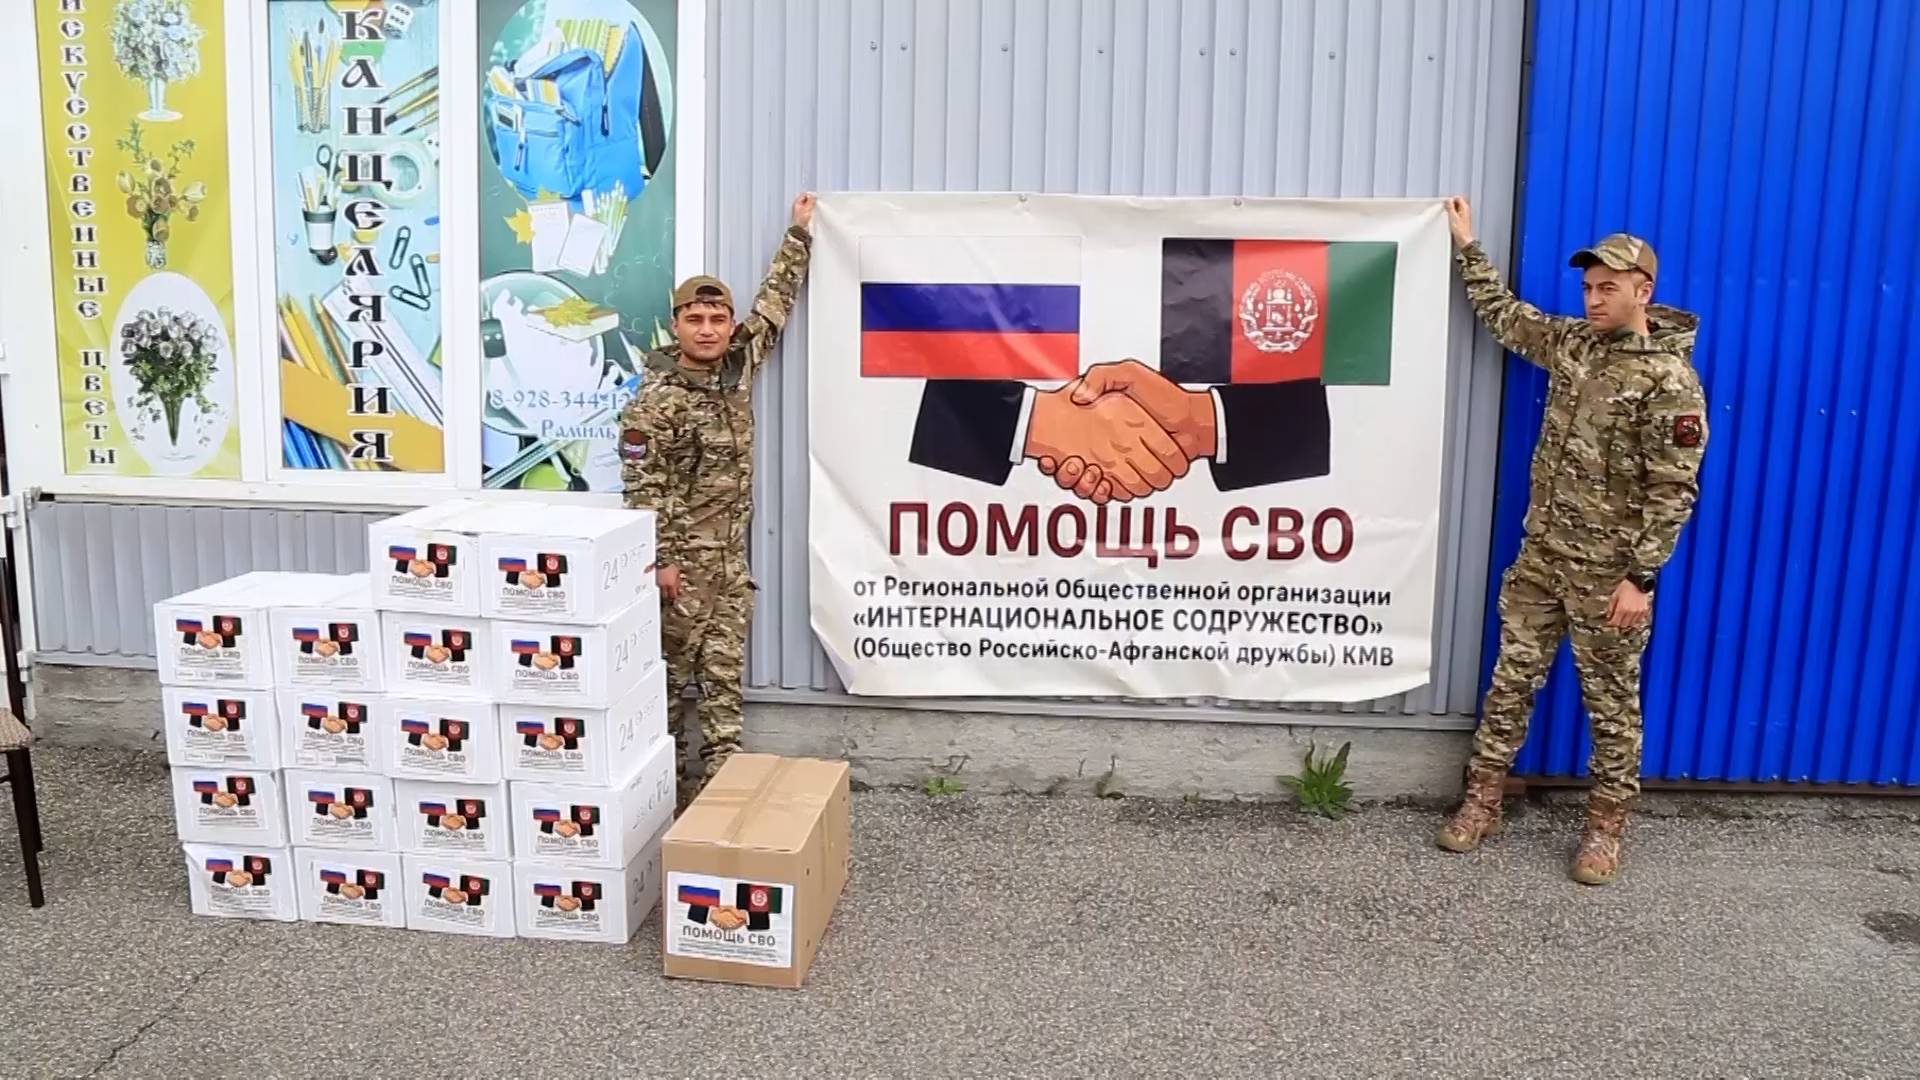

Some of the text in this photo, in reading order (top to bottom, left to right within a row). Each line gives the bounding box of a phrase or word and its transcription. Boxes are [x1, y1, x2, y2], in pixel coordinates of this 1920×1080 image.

[341, 11, 392, 460] КАНЦЕЛЯРИЯ
[82, 351, 115, 464] ЦВЕТЫ
[889, 502, 1354, 568] ПОМОЩЬ СВО
[853, 576, 1391, 607] от Региональной Общественной организации
[853, 606, 1383, 636] «ИНТЕРНАЦИОНАЛЬНОЕ СОДРУЖЕСТВО»
[853, 637, 1393, 668] (Общество Российско-Афганской дружбы) КМВ
[682, 925, 776, 947] ПОМОЩЬ СВО
